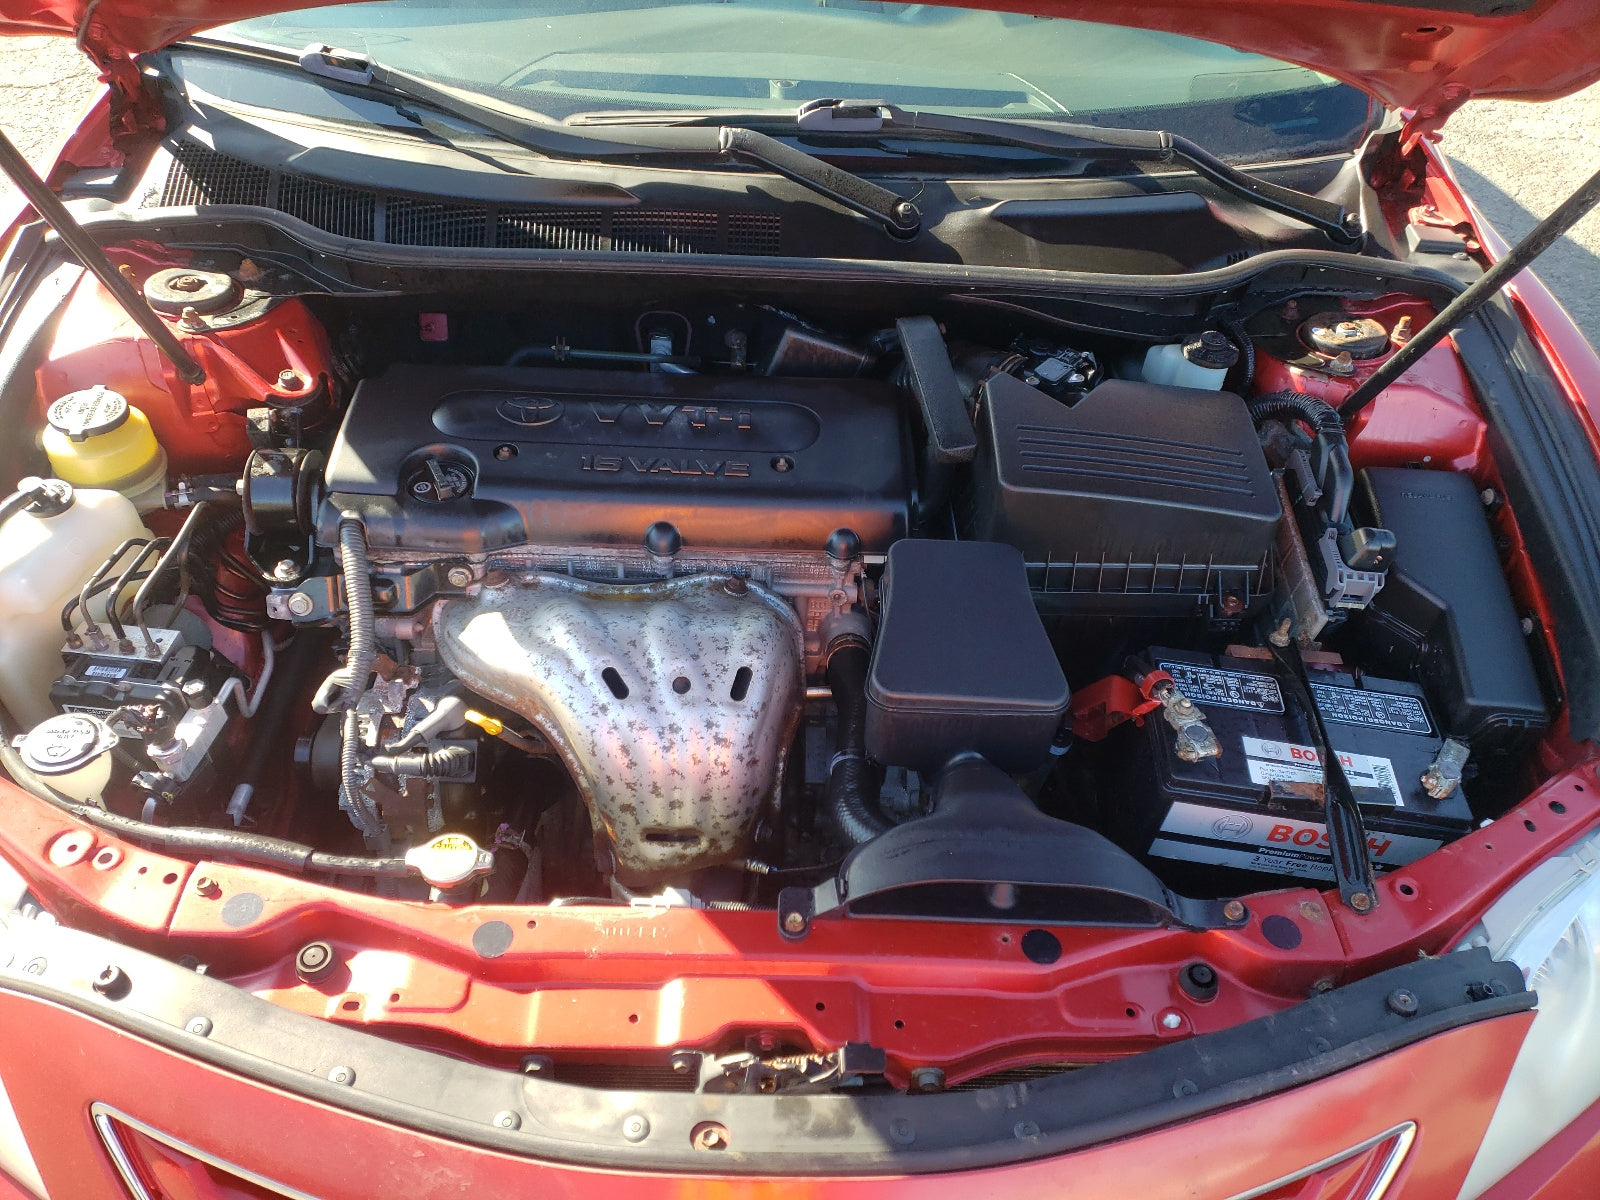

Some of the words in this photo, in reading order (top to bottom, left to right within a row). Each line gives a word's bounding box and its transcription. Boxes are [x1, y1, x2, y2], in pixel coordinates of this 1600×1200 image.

[582, 455, 623, 472] 16
[628, 456, 750, 477] VALVE
[1266, 824, 1393, 857] BOSH
[1264, 857, 1282, 865] Year
